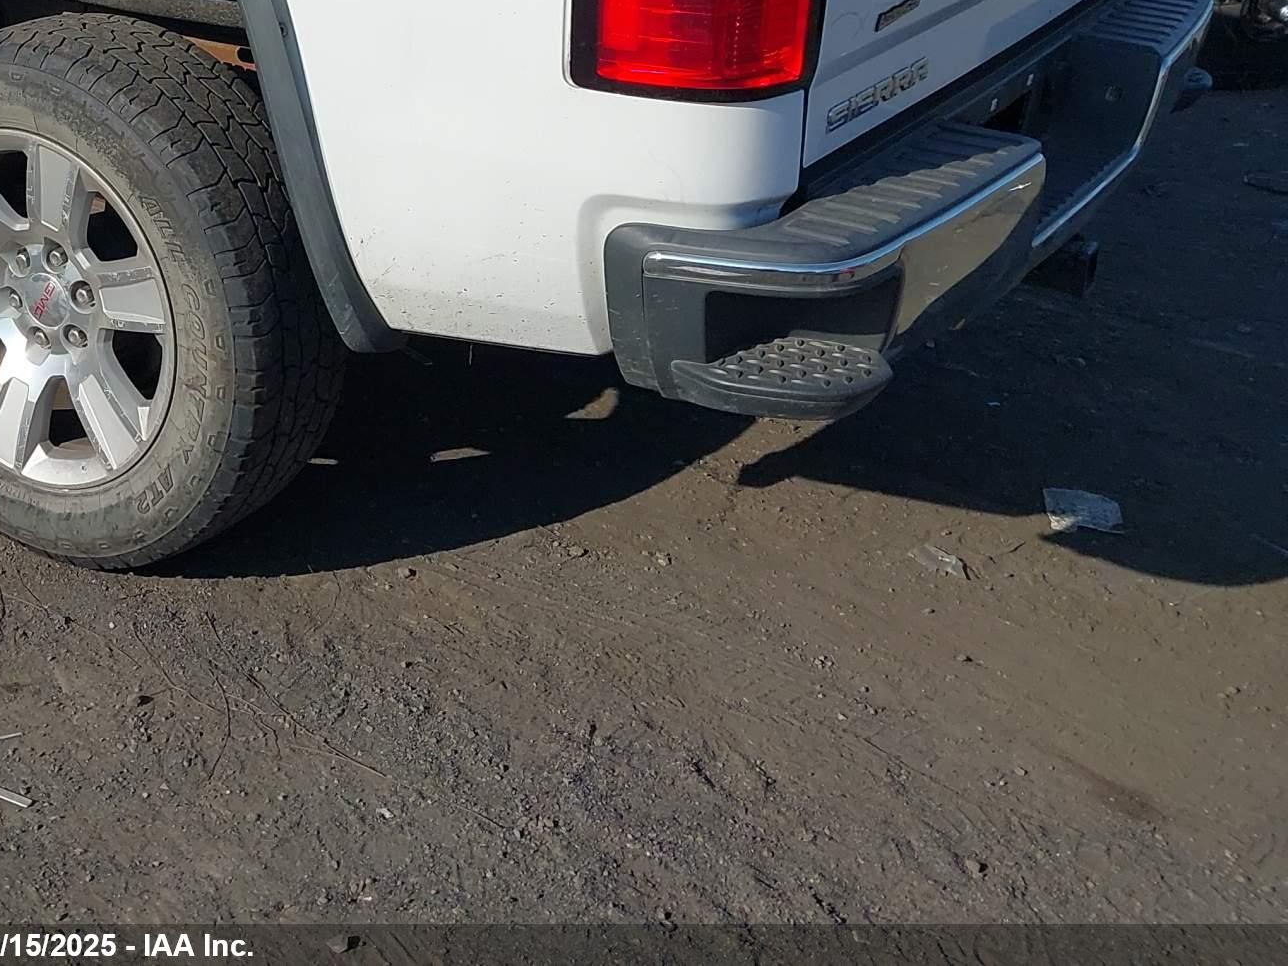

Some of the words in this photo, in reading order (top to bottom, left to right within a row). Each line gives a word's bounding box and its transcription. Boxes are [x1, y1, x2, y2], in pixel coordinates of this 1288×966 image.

[825, 56, 929, 134] SIERRA
[139, 195, 186, 264] ALL
[32, 280, 56, 320] GMC
[136, 463, 175, 515] AT2
